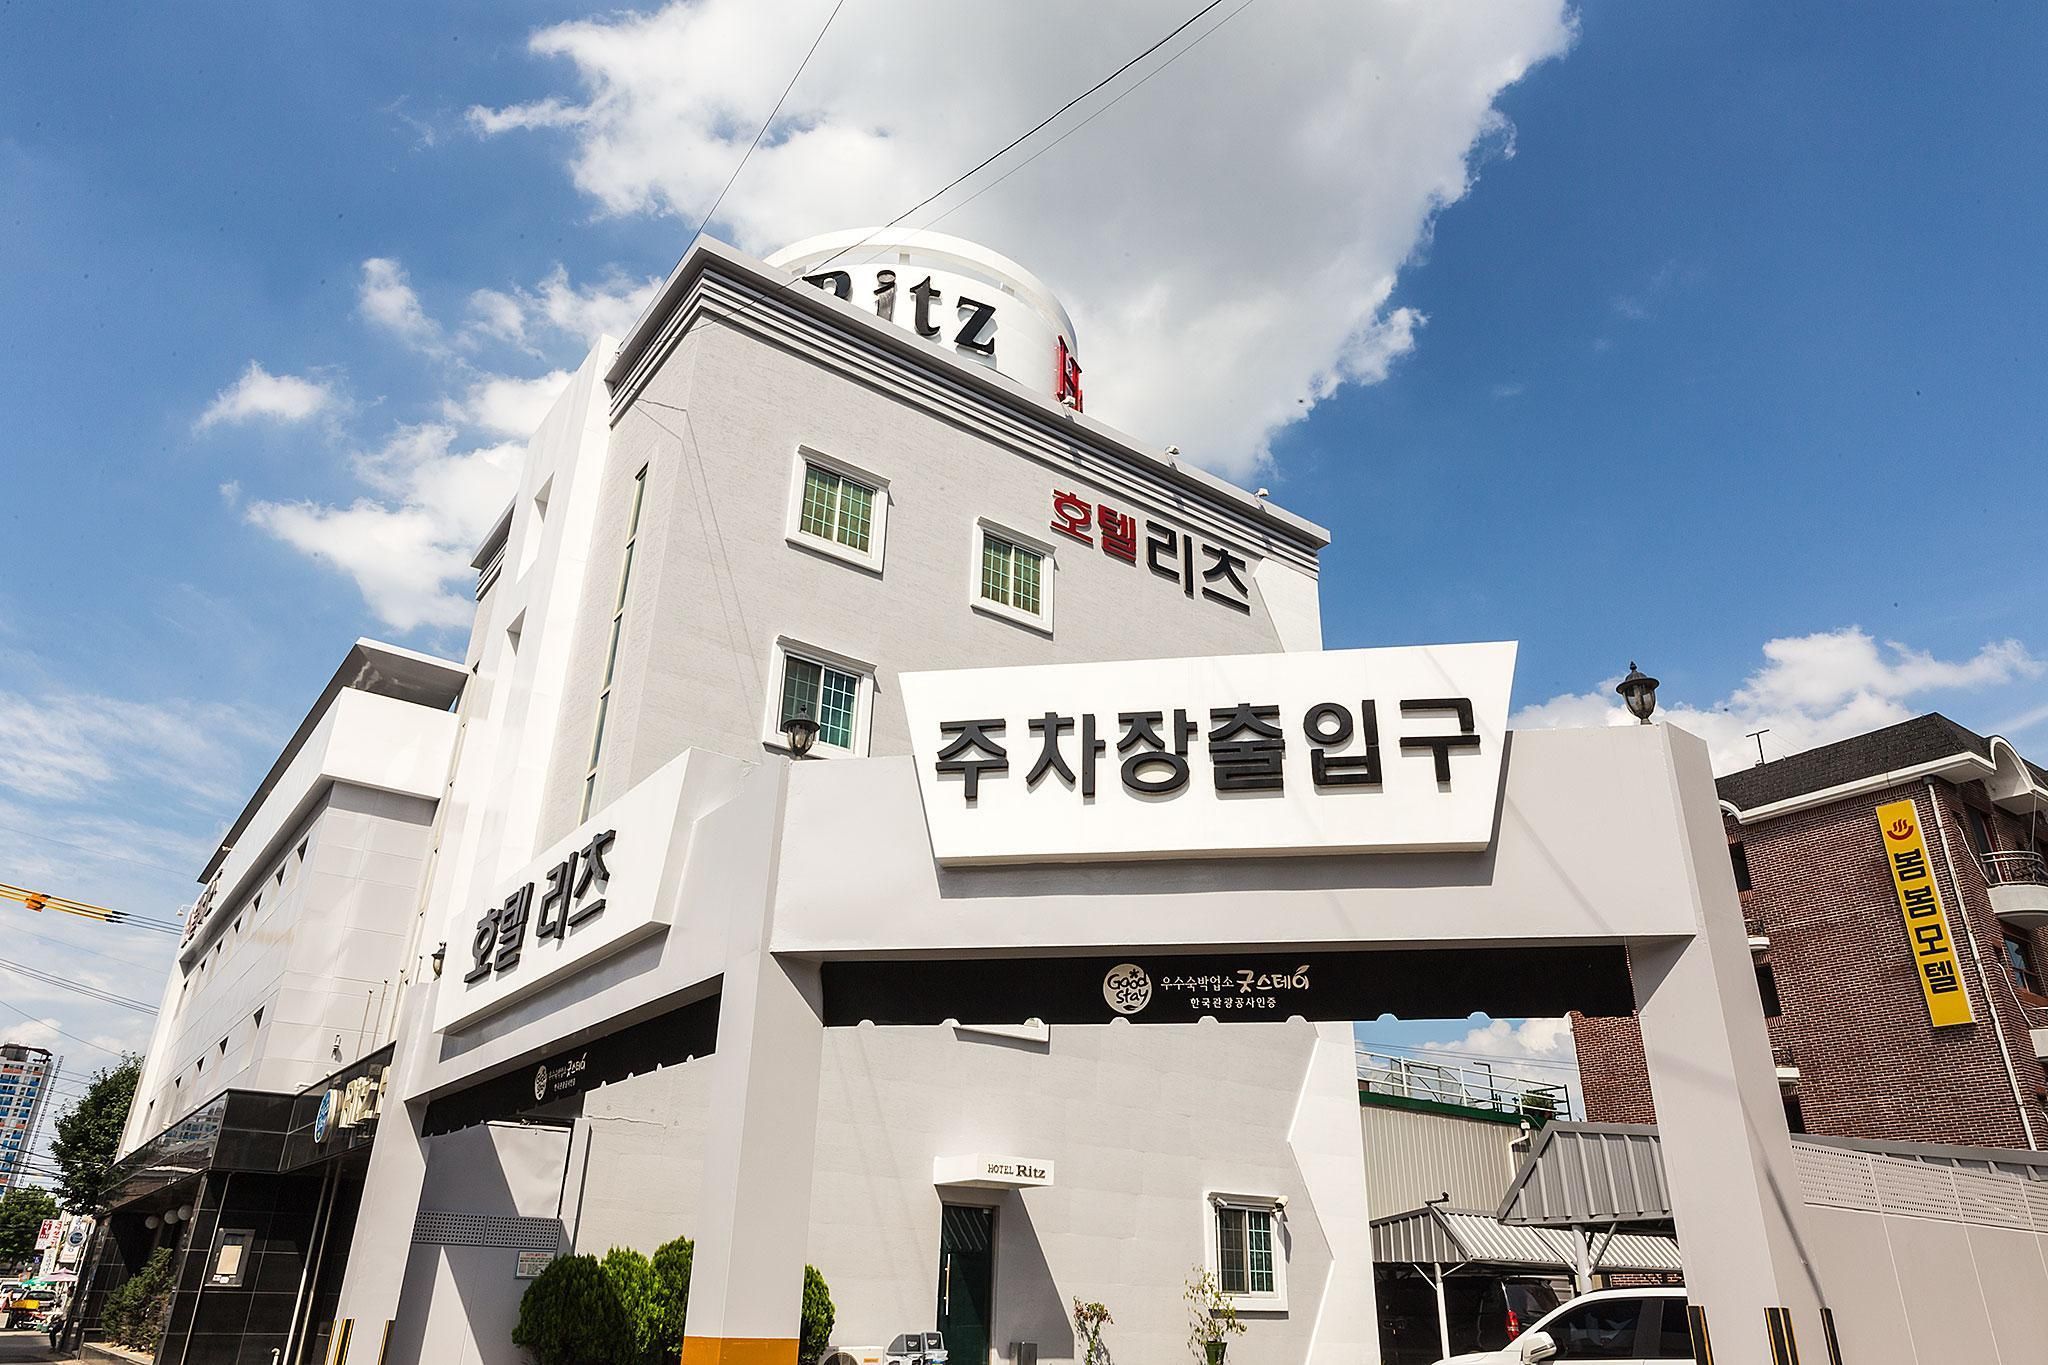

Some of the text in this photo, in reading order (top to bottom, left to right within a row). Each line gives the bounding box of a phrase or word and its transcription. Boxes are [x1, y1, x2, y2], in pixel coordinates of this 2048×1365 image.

[935, 697, 1480, 804] 주차장출입구
[463, 829, 617, 983] 호텔 리츠
[1893, 848, 1959, 994] 봉봉모텔
[1107, 971, 1149, 990] Good
[1160, 975, 1235, 992] 우수숙박업소
[1189, 996, 1277, 1009] 한국관광공사인증
[987, 1163, 1046, 1179] HOTEL Ritz
